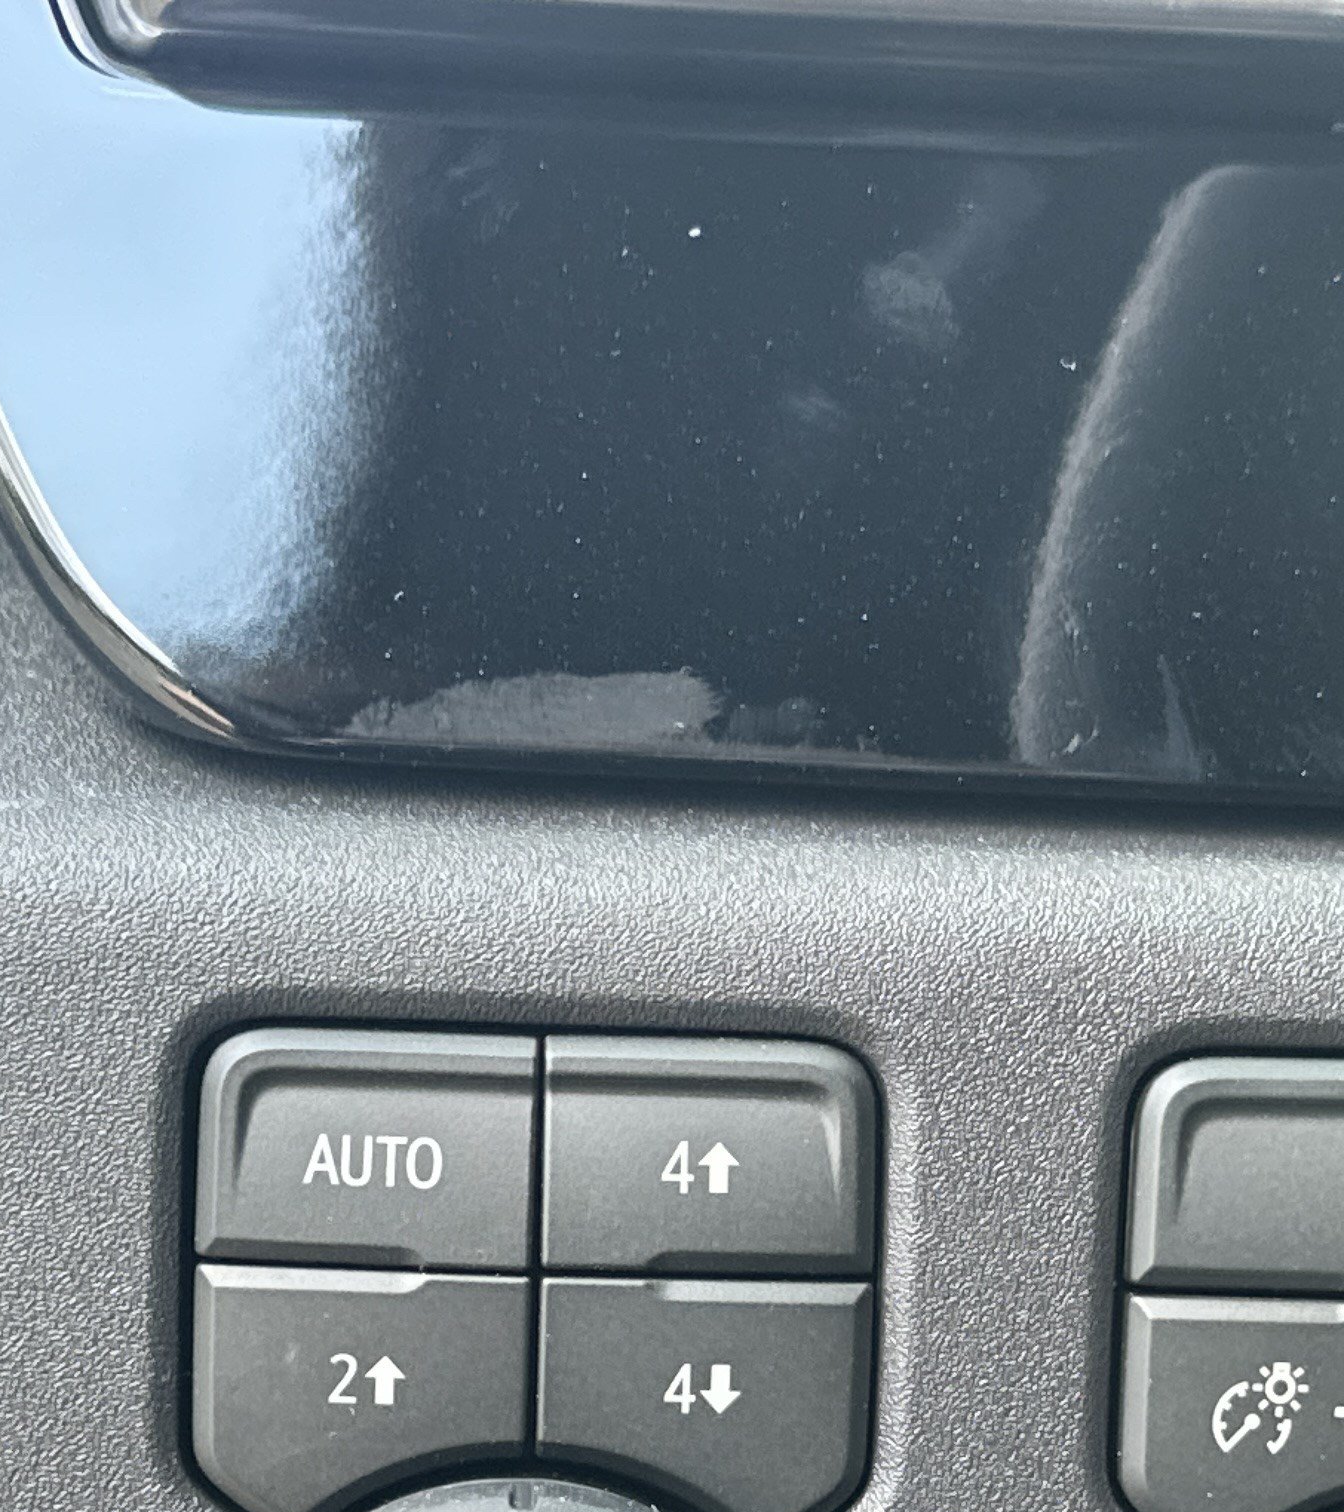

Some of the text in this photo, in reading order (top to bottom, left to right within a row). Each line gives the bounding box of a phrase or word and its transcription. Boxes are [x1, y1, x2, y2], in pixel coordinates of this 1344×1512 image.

[302, 1133, 443, 1190] AUTO
[661, 1140, 695, 1194] 4
[327, 1352, 358, 1405] 2
[663, 1363, 697, 1415] 4
